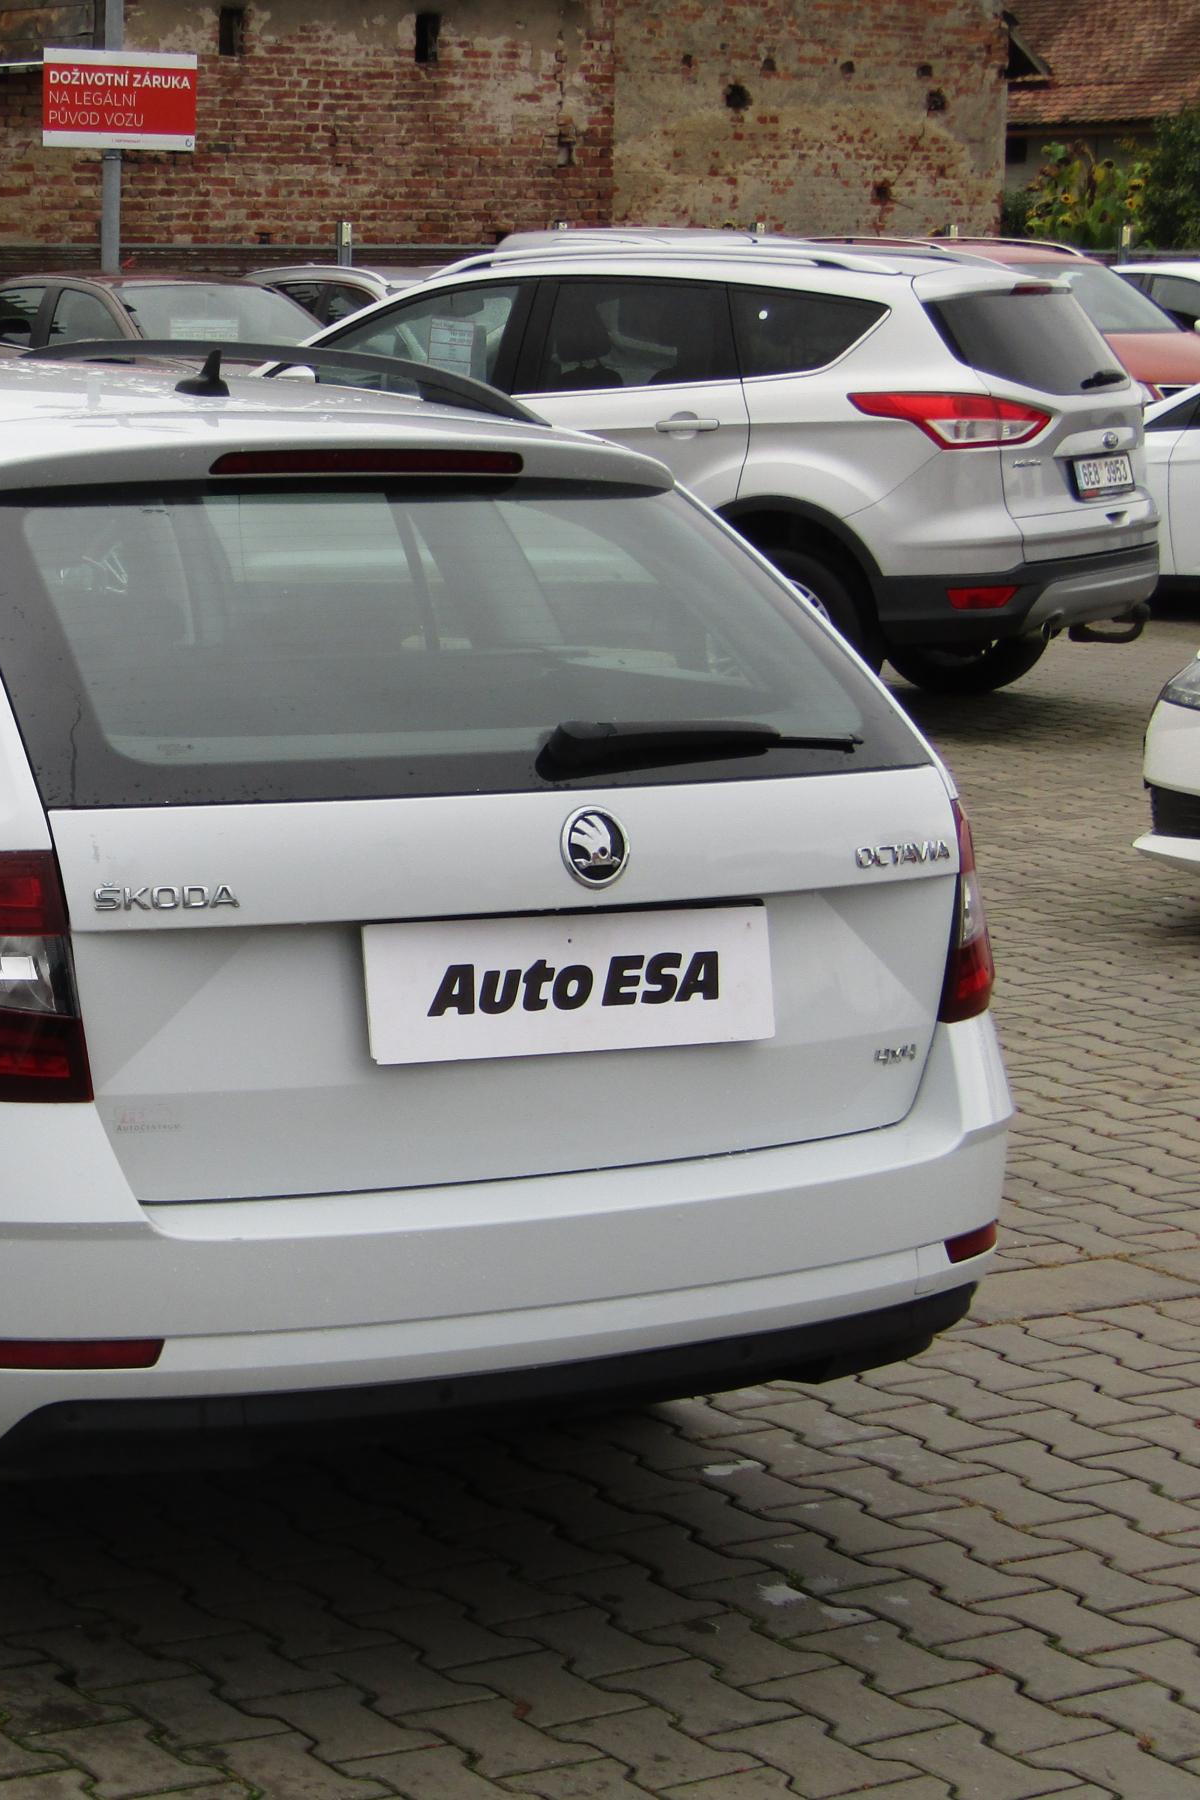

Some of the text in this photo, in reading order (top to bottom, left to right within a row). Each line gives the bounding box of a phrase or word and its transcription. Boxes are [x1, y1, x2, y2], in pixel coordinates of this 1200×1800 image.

[49, 68, 191, 90] DOŽIVOTNÍ ZÁRUKA
[49, 90, 137, 107] NA LEGÁLNÍ
[48, 107, 144, 127] PŮVOD VOZU
[855, 840, 951, 869] OCTAVIA
[94, 881, 241, 911] ŠKODA
[426, 950, 720, 1018] Auto ESA
